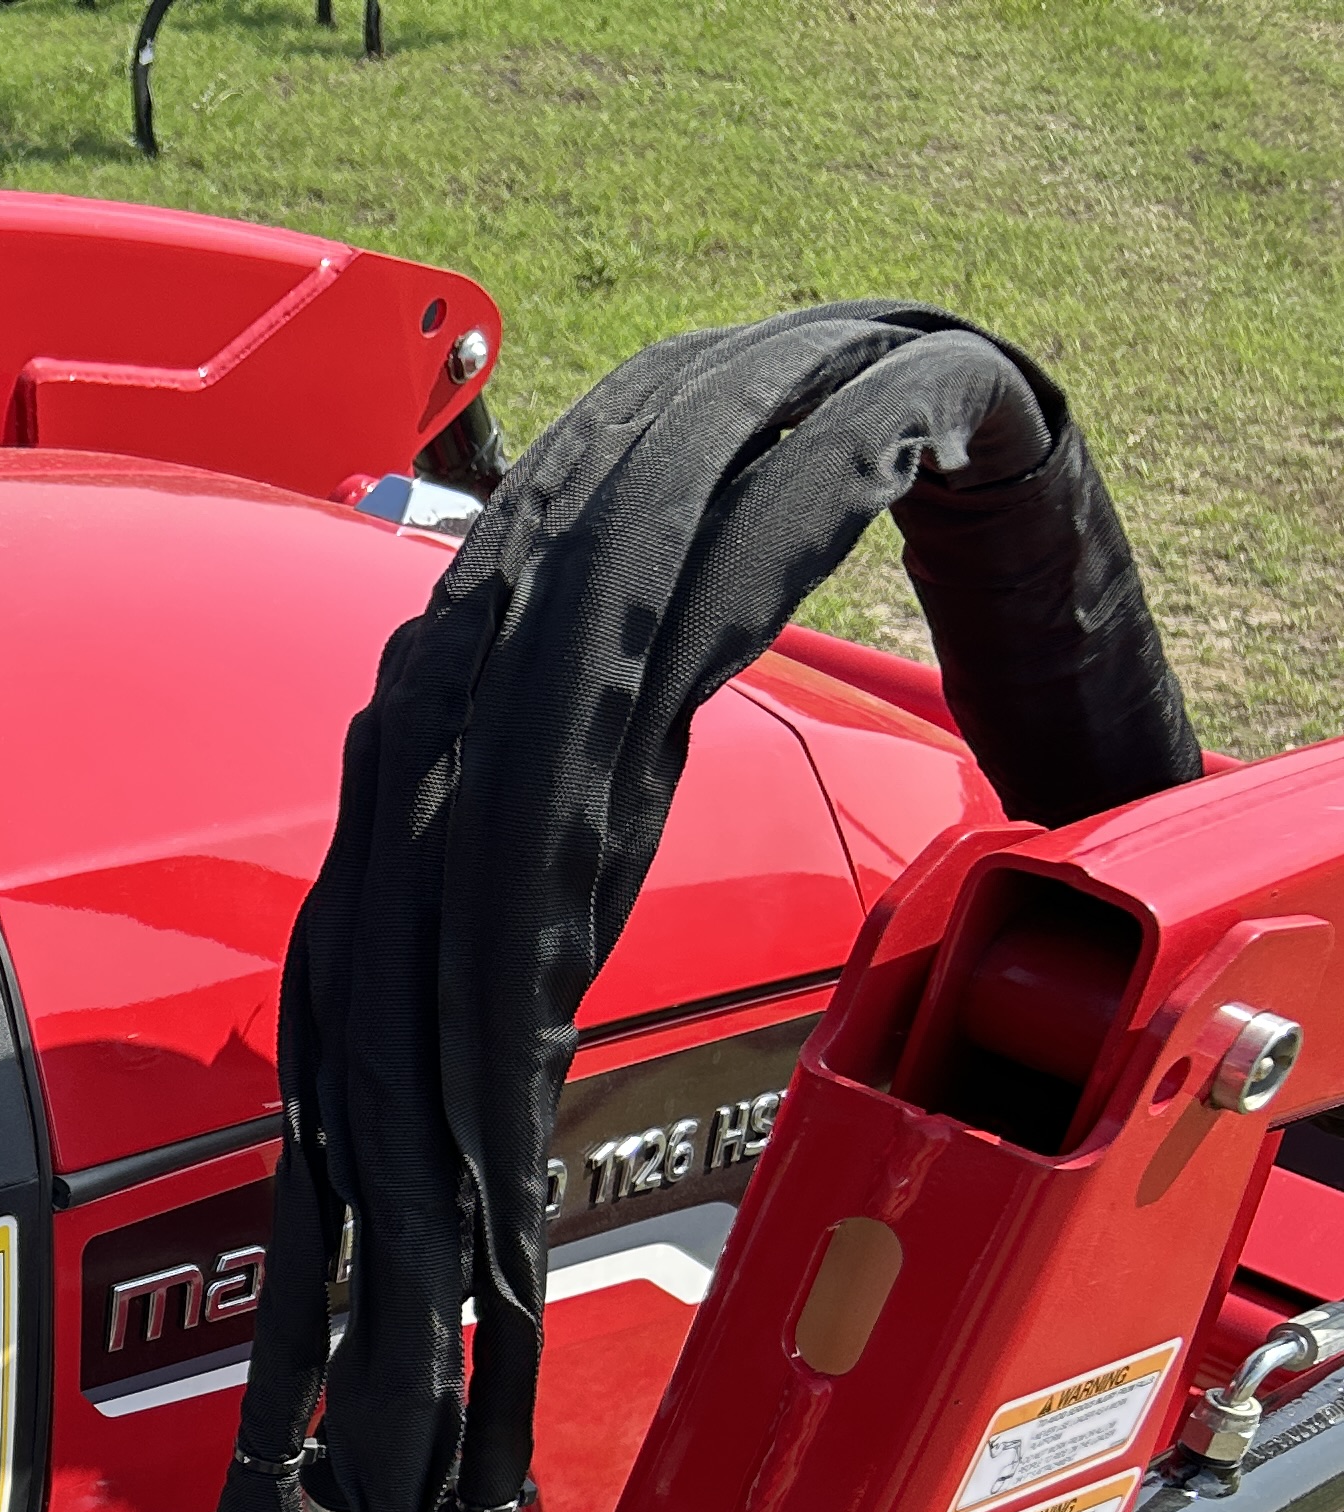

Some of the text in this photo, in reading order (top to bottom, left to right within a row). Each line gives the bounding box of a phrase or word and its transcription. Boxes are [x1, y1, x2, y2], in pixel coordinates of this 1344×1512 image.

[588, 1118, 700, 1204] 1126
[711, 1089, 788, 1169] HS
[1057, 1366, 1130, 1410] WARNING
